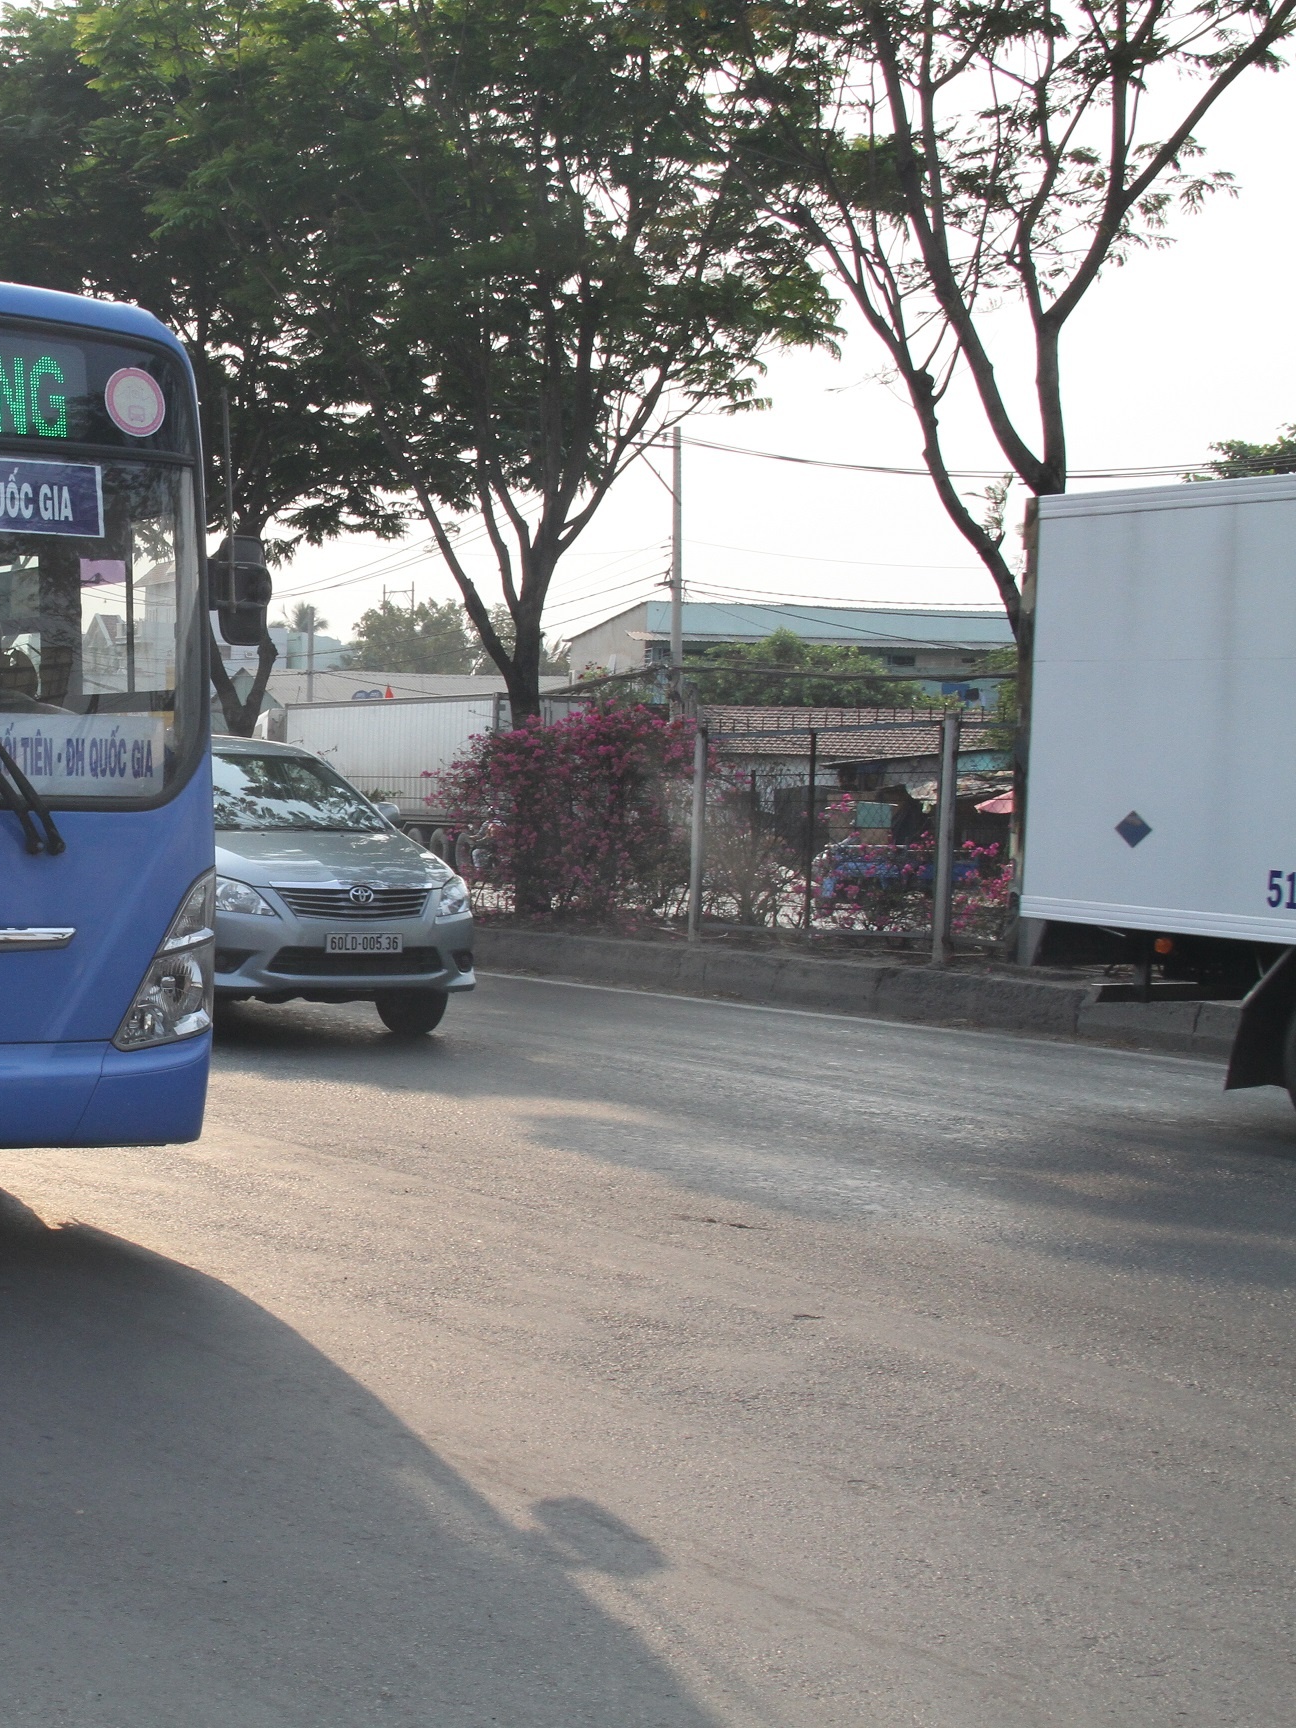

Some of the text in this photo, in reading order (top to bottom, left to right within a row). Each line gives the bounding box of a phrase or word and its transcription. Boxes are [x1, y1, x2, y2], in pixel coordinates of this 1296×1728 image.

[39, 483, 73, 521] GIA
[21, 728, 53, 776] TIÊN
[89, 725, 127, 779] QUỐC
[131, 739, 153, 779] GIA
